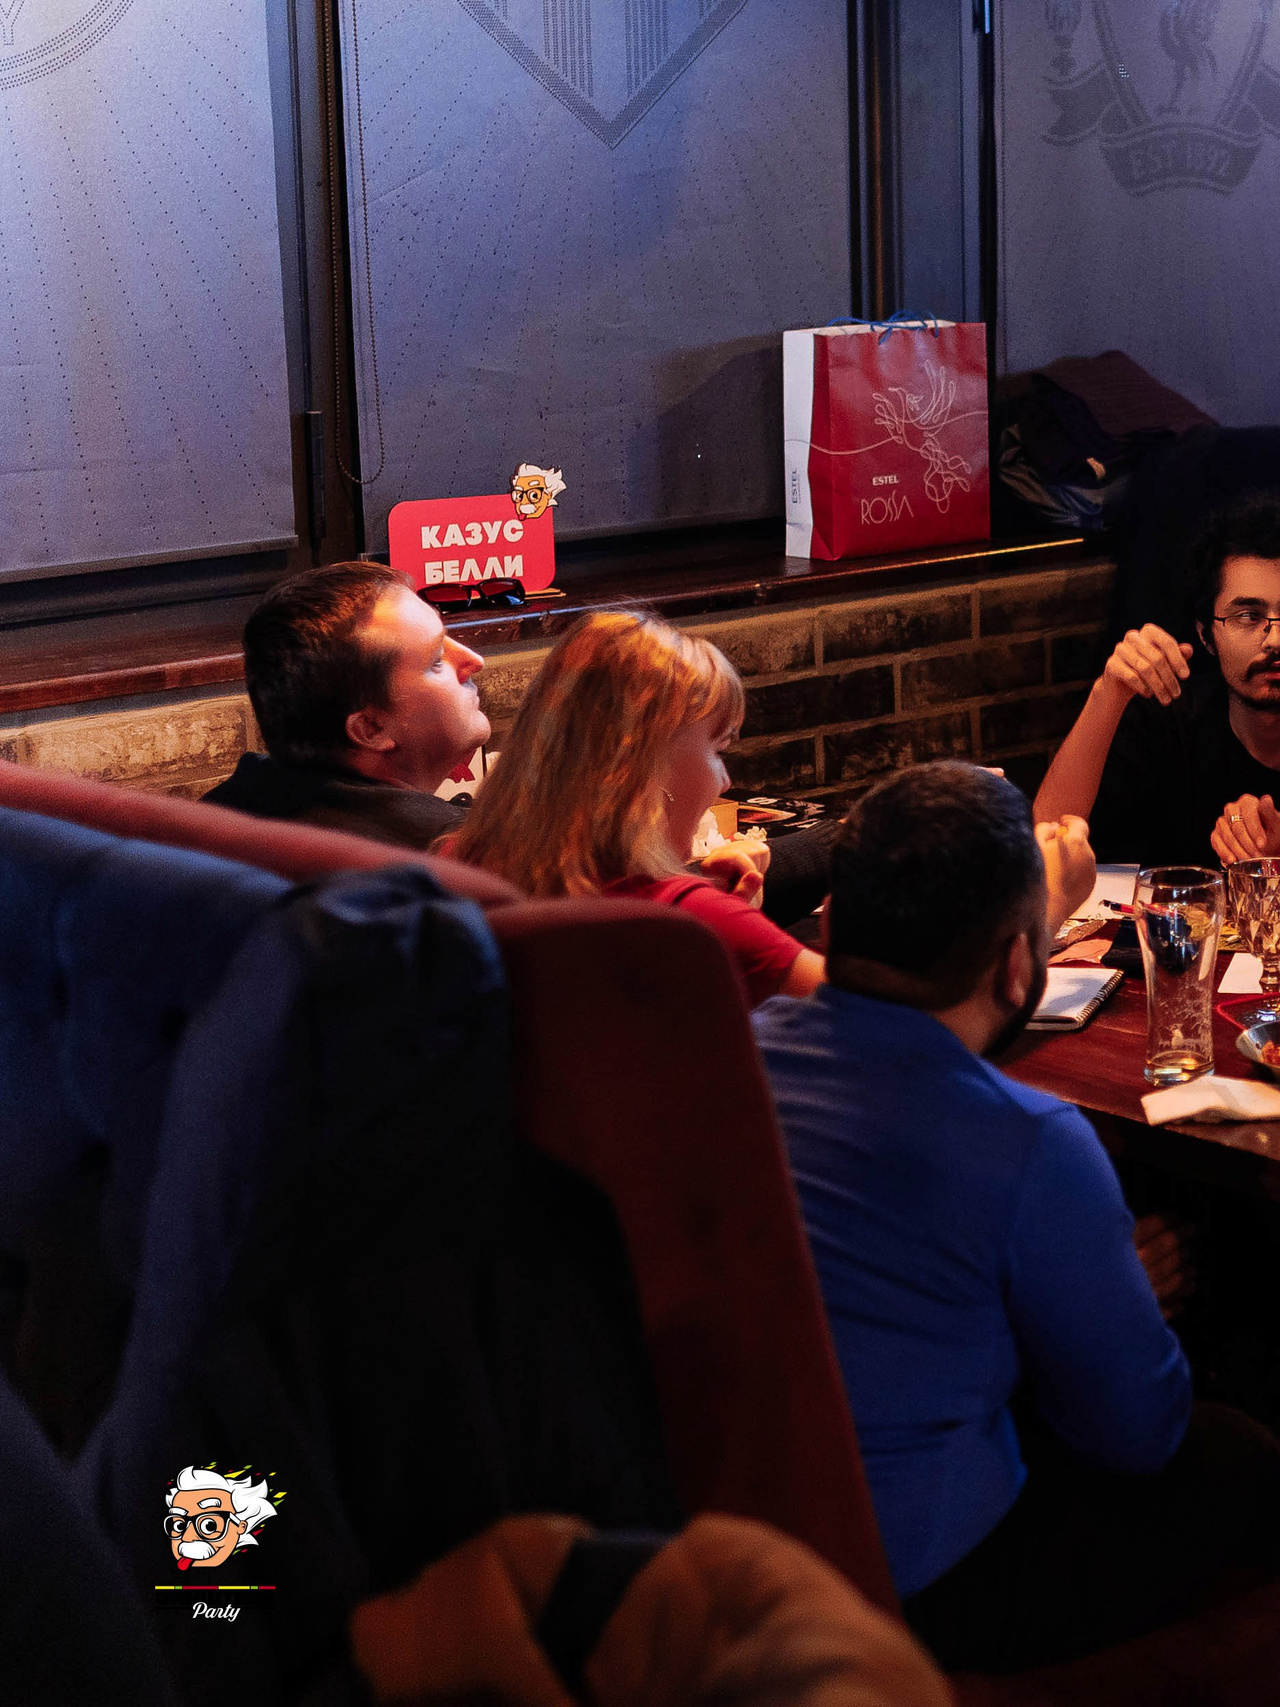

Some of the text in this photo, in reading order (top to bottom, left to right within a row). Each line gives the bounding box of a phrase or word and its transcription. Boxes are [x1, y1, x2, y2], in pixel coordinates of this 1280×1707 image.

[872, 474, 899, 486] ESTEL
[421, 519, 524, 550] КАЗУС
[424, 554, 524, 585] БЕЛЛИ
